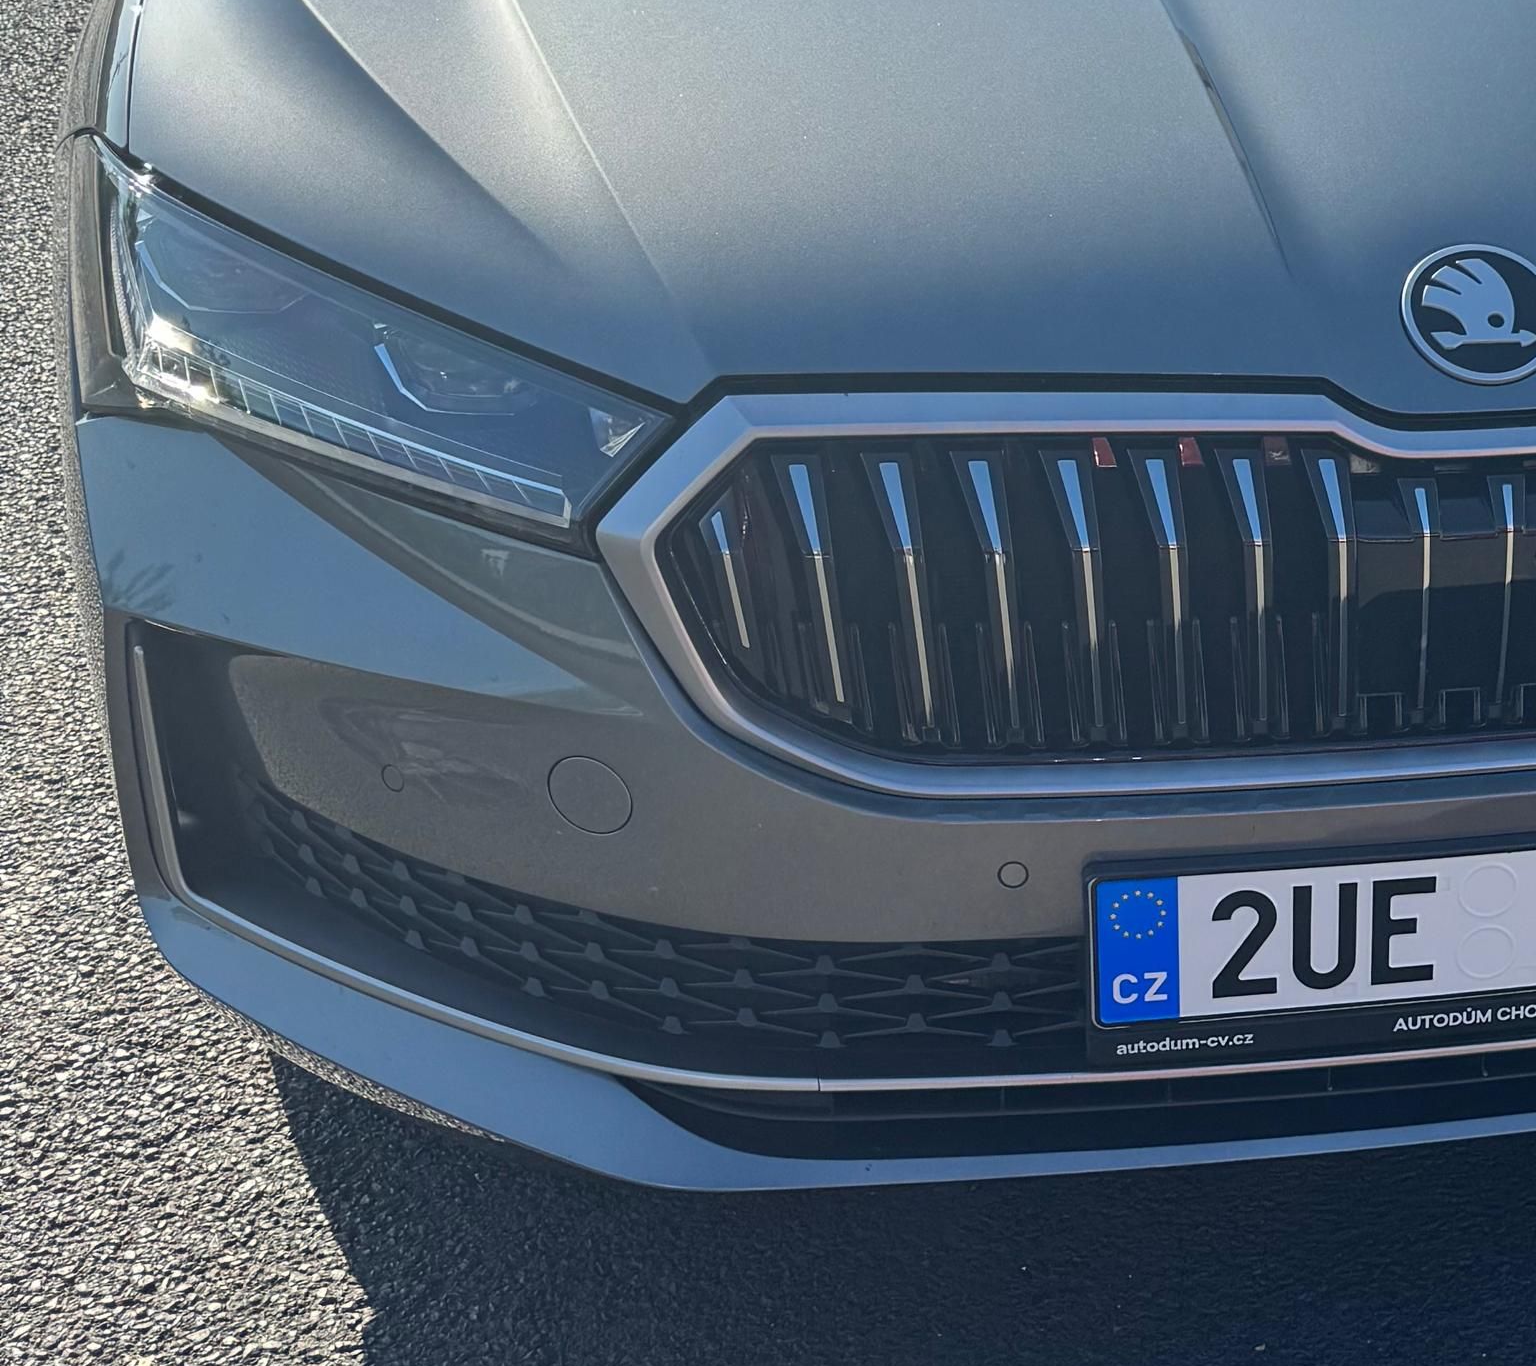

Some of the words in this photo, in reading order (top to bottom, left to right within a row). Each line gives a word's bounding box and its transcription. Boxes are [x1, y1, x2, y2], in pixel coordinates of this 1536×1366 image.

[1212, 876, 1437, 999] 2UE
[1112, 971, 1168, 1005] CZ
[1392, 1006, 1492, 1032] AUTODŮM
[1116, 1033, 1254, 1055] autodum-cv.cz
